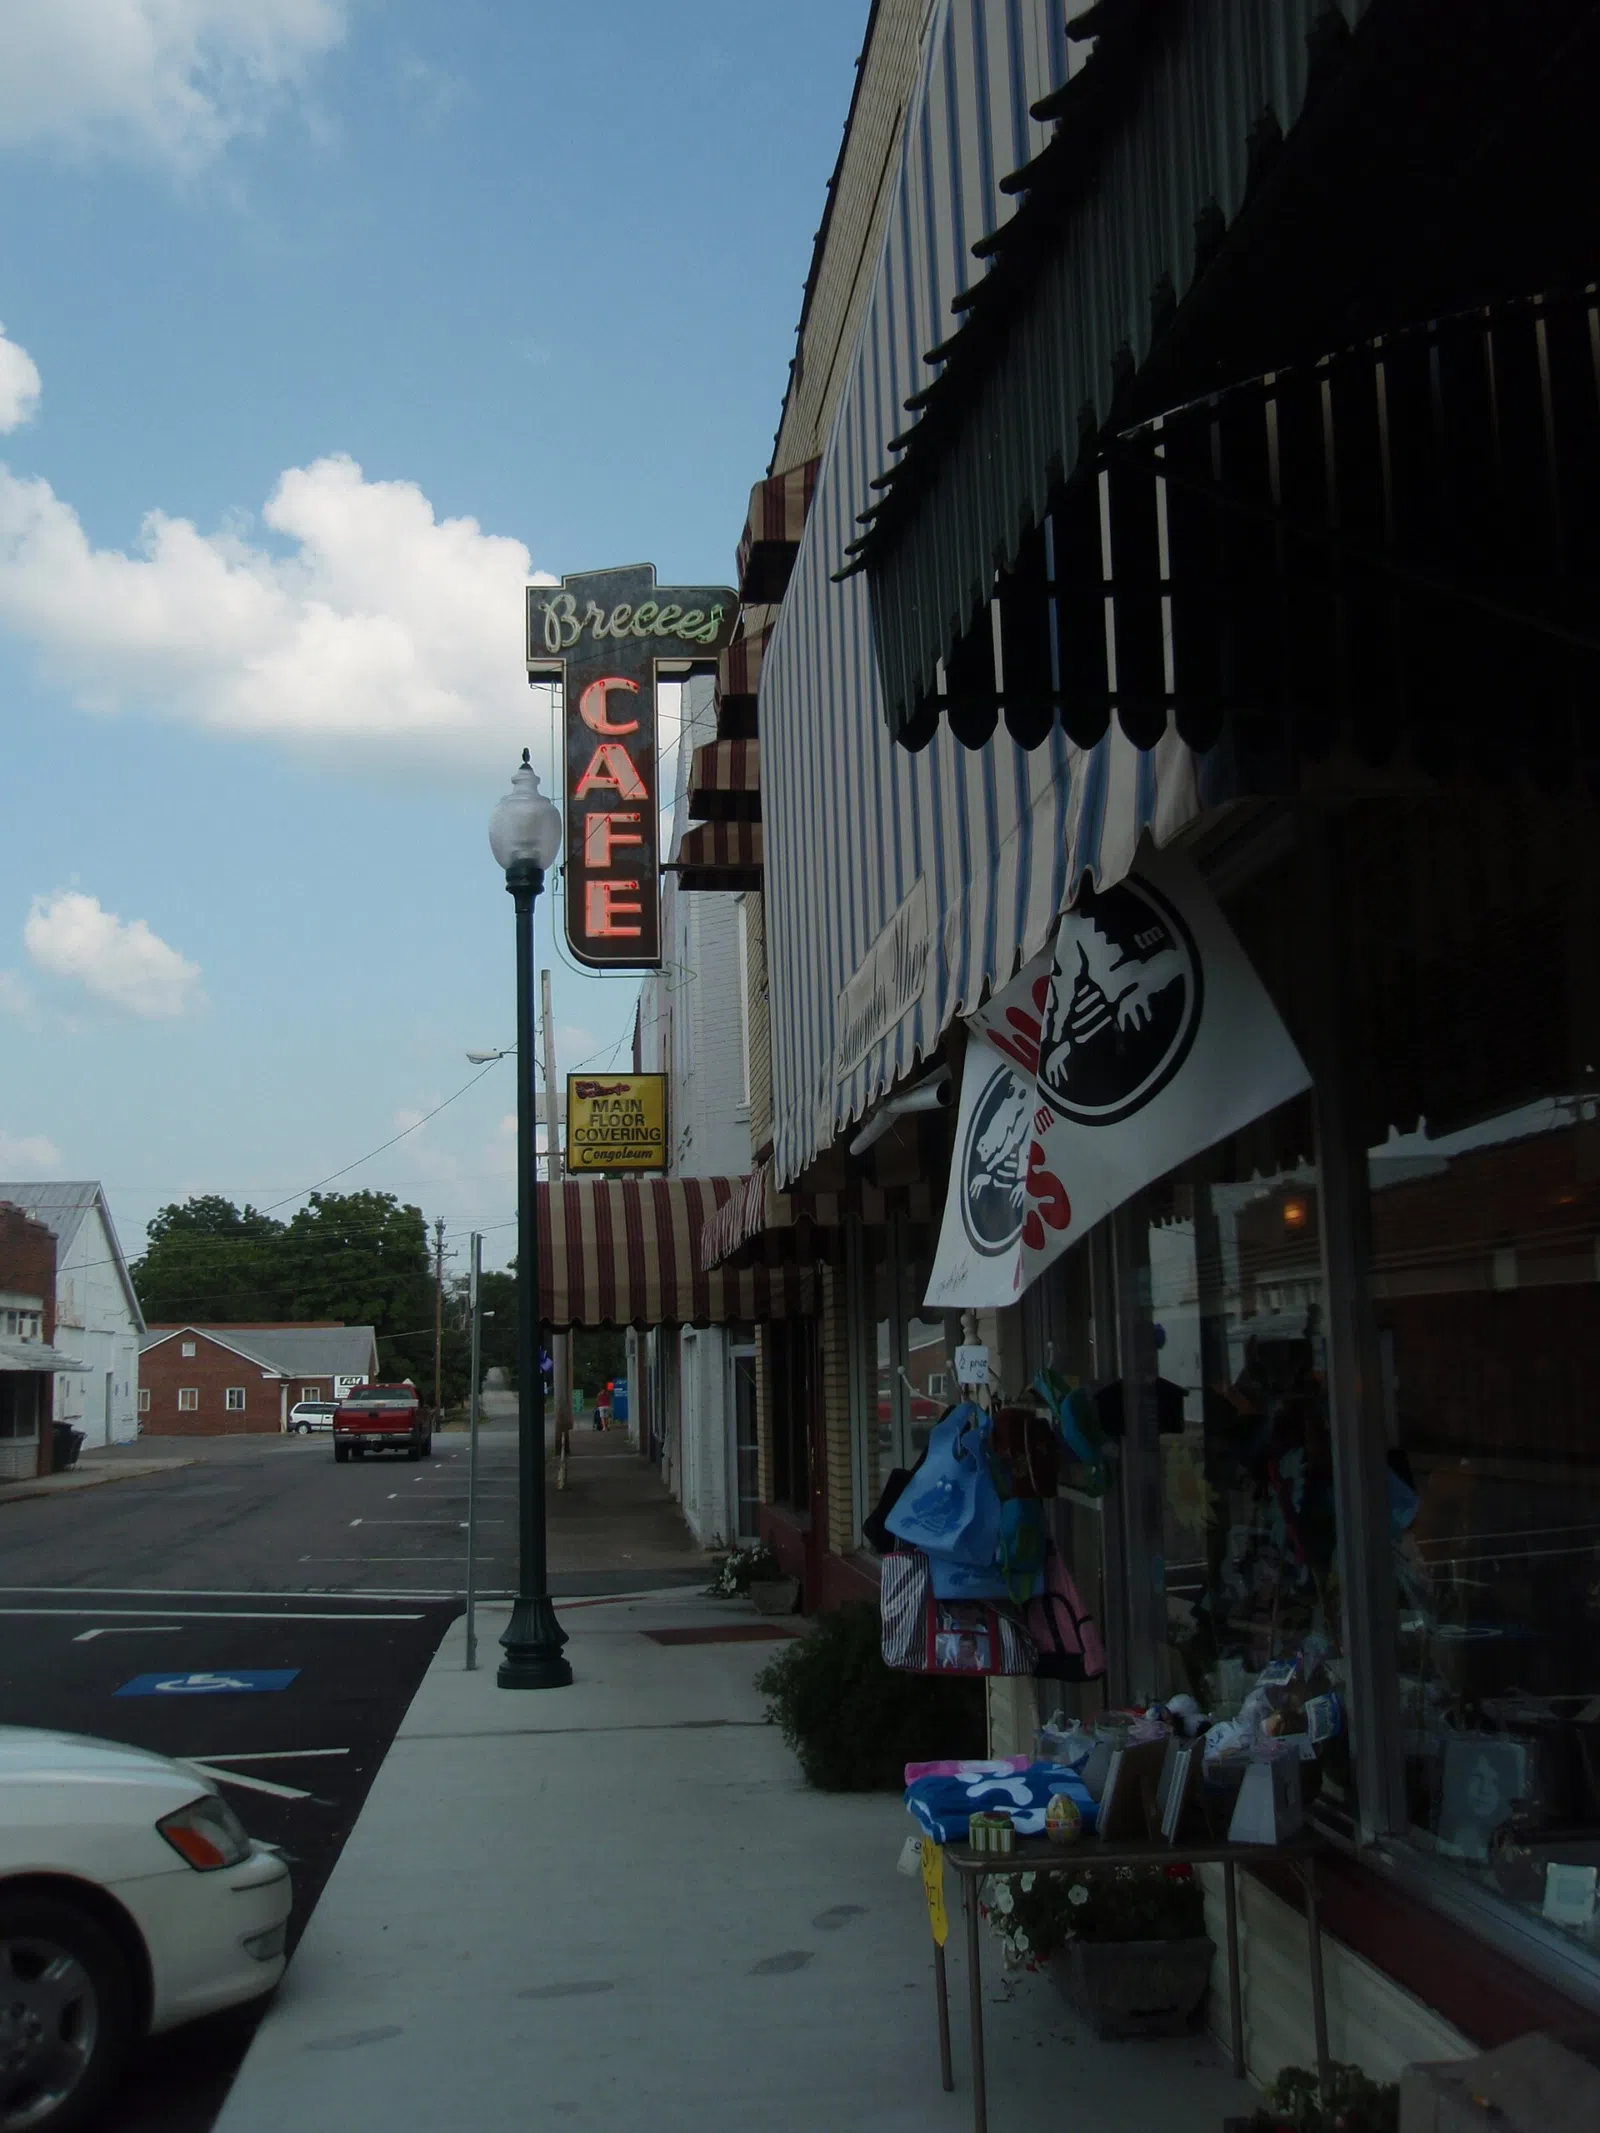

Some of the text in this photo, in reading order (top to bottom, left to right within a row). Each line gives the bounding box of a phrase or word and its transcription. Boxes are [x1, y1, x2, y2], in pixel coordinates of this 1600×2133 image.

[574, 677, 649, 938] CAFE
[1133, 926, 1165, 950] tm
[592, 1099, 643, 1113] MAIN
[590, 1113, 645, 1127] FLOOR
[575, 1127, 661, 1141] COVERING
[582, 1146, 653, 1164] Congoleum
[969, 1359, 988, 1372] price
